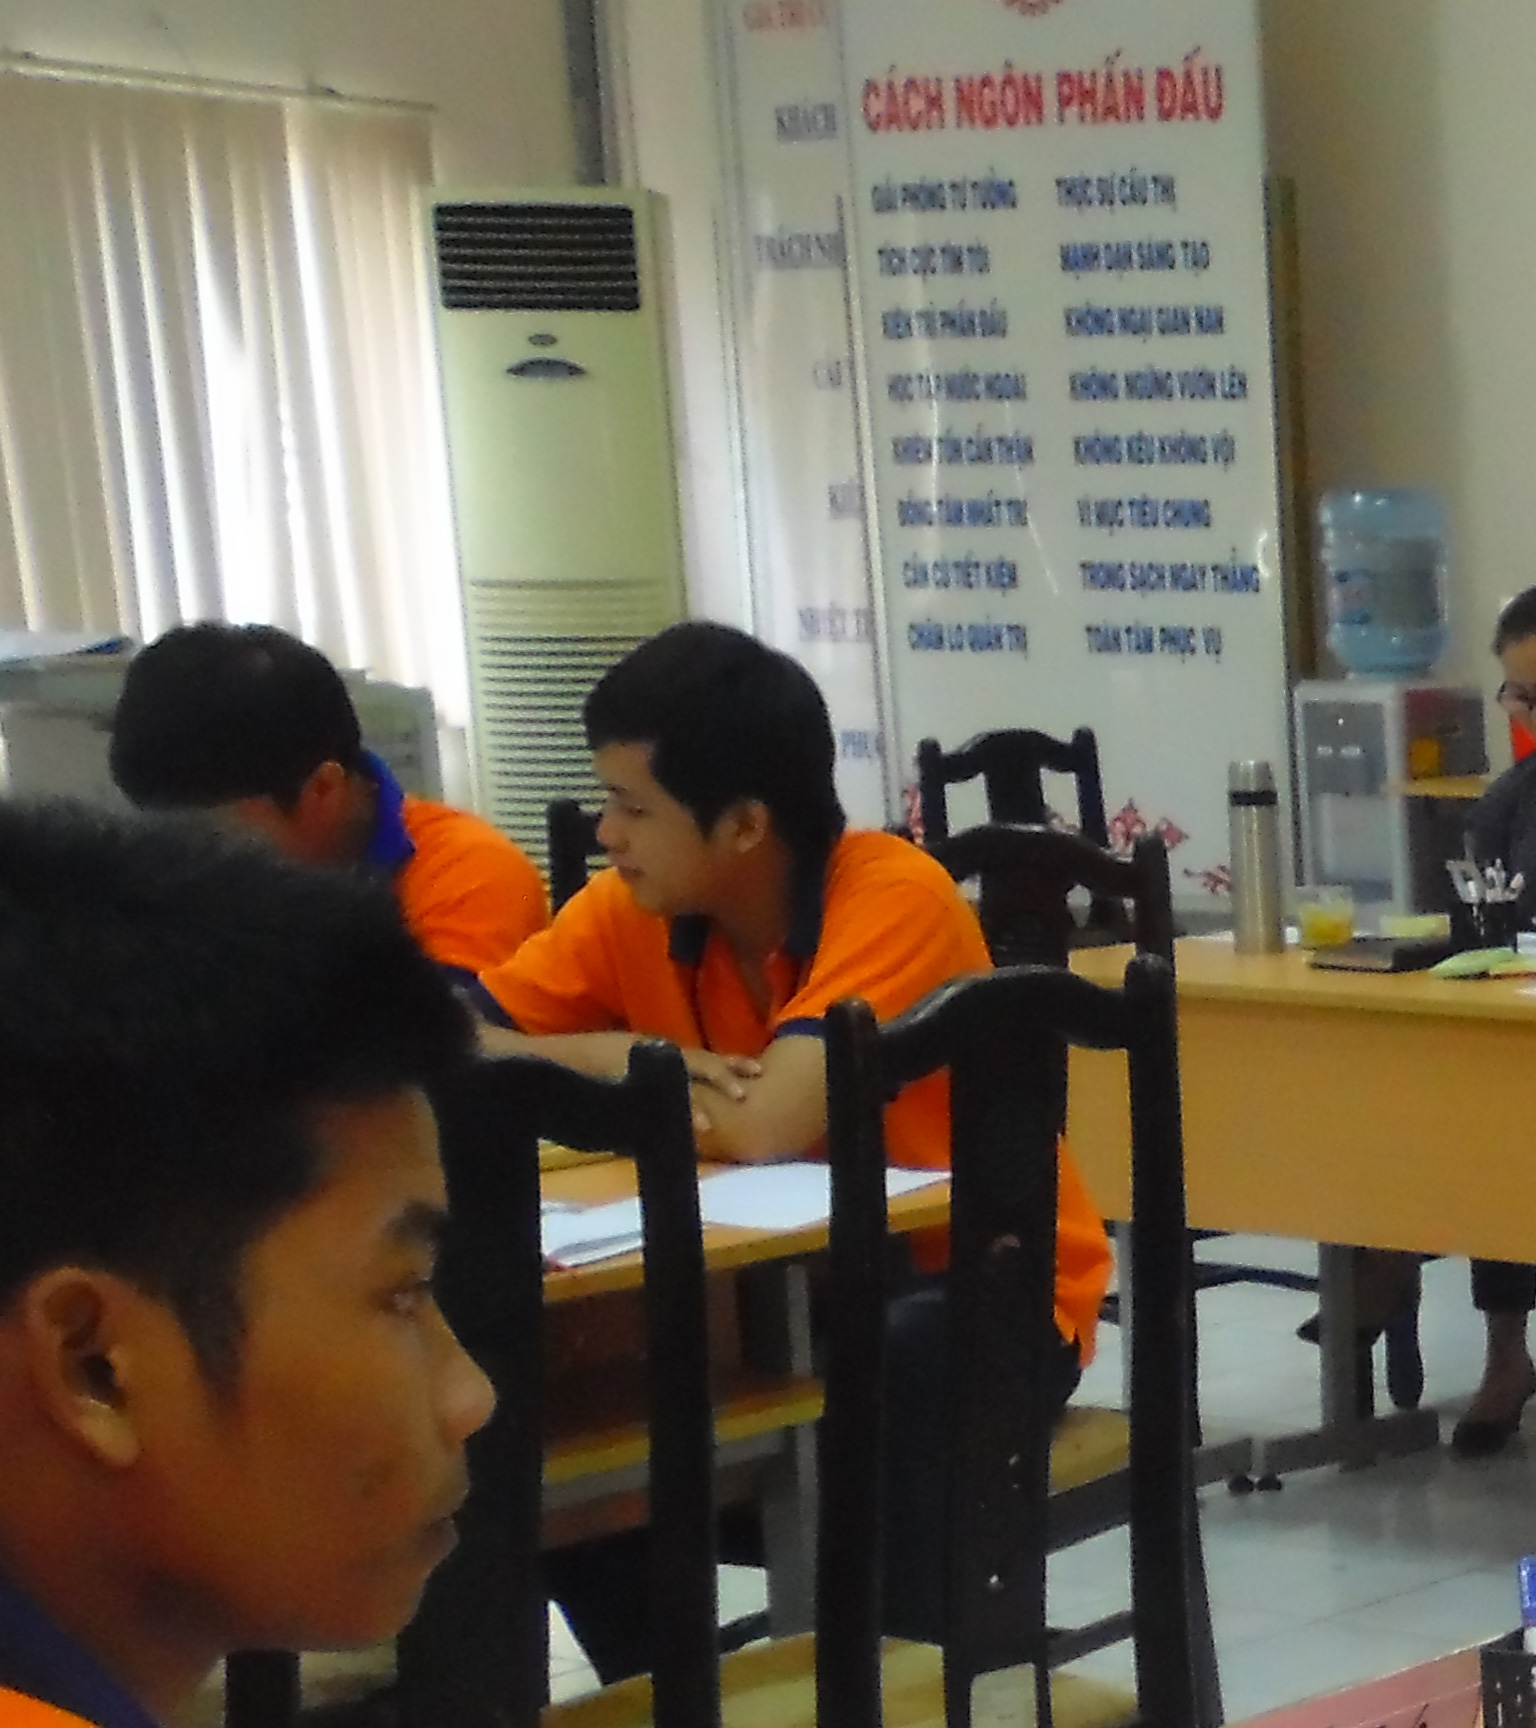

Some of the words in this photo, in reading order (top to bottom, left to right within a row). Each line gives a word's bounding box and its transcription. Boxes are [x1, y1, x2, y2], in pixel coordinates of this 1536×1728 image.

[862, 66, 946, 133] CÁCH
[953, 59, 1044, 129] NGÔN
[1056, 48, 1147, 125] PHẤN
[1154, 45, 1224, 122] ĐẤU
